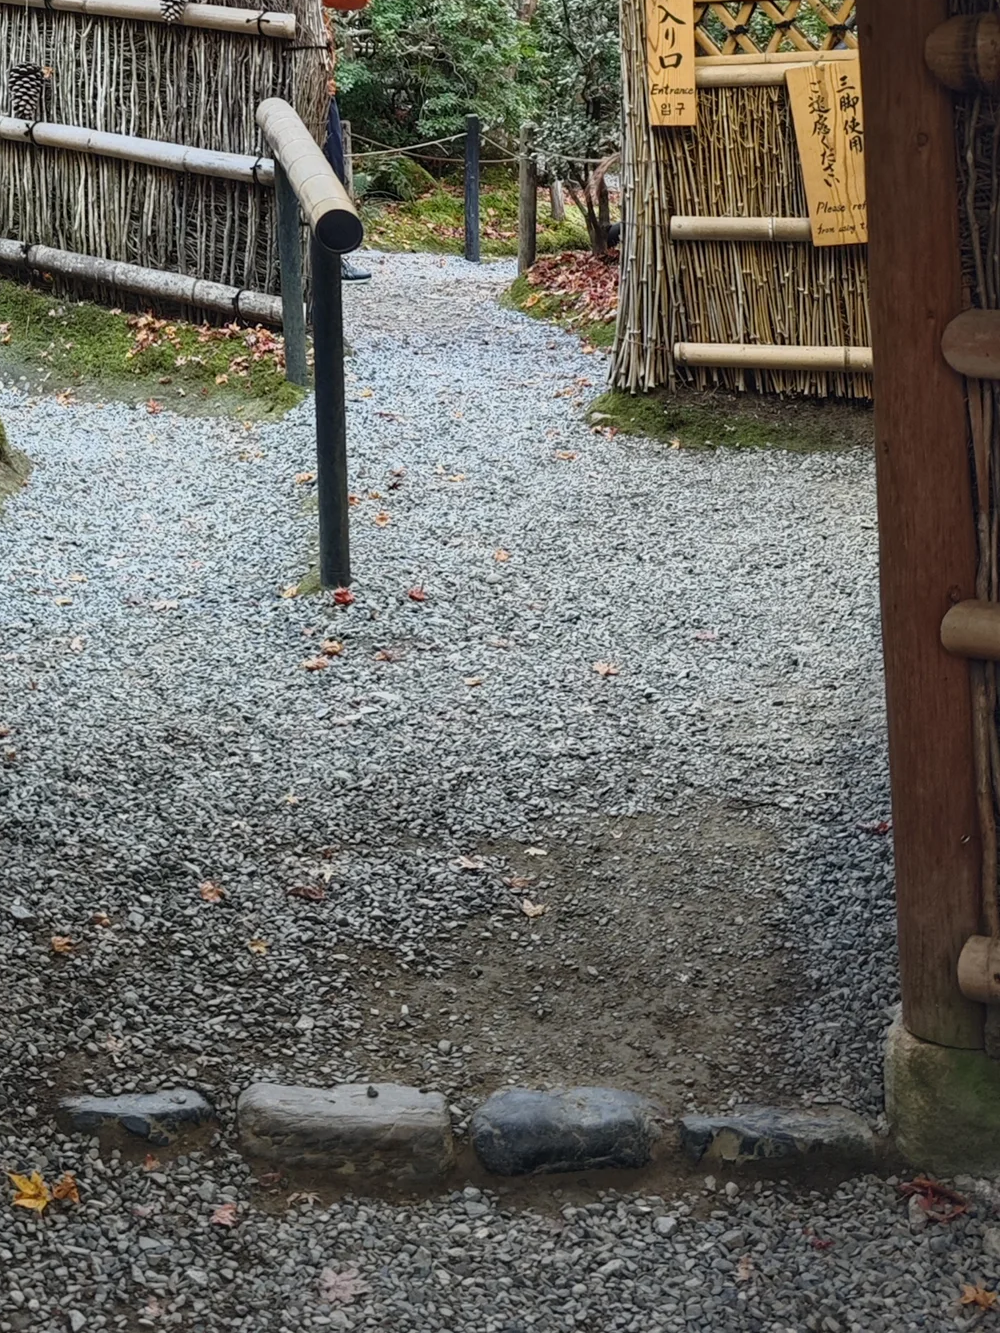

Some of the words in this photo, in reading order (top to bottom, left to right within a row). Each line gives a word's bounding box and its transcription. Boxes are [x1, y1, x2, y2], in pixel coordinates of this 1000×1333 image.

[657, 5, 686, 69] 入り口
[650, 83, 694, 96] Entrance
[661, 102, 685, 116] 입구
[836, 75, 864, 154] 三脚使用
[808, 80, 839, 187] ご遠慮ください
[816, 201, 845, 215] Please
[817, 223, 835, 235] from
